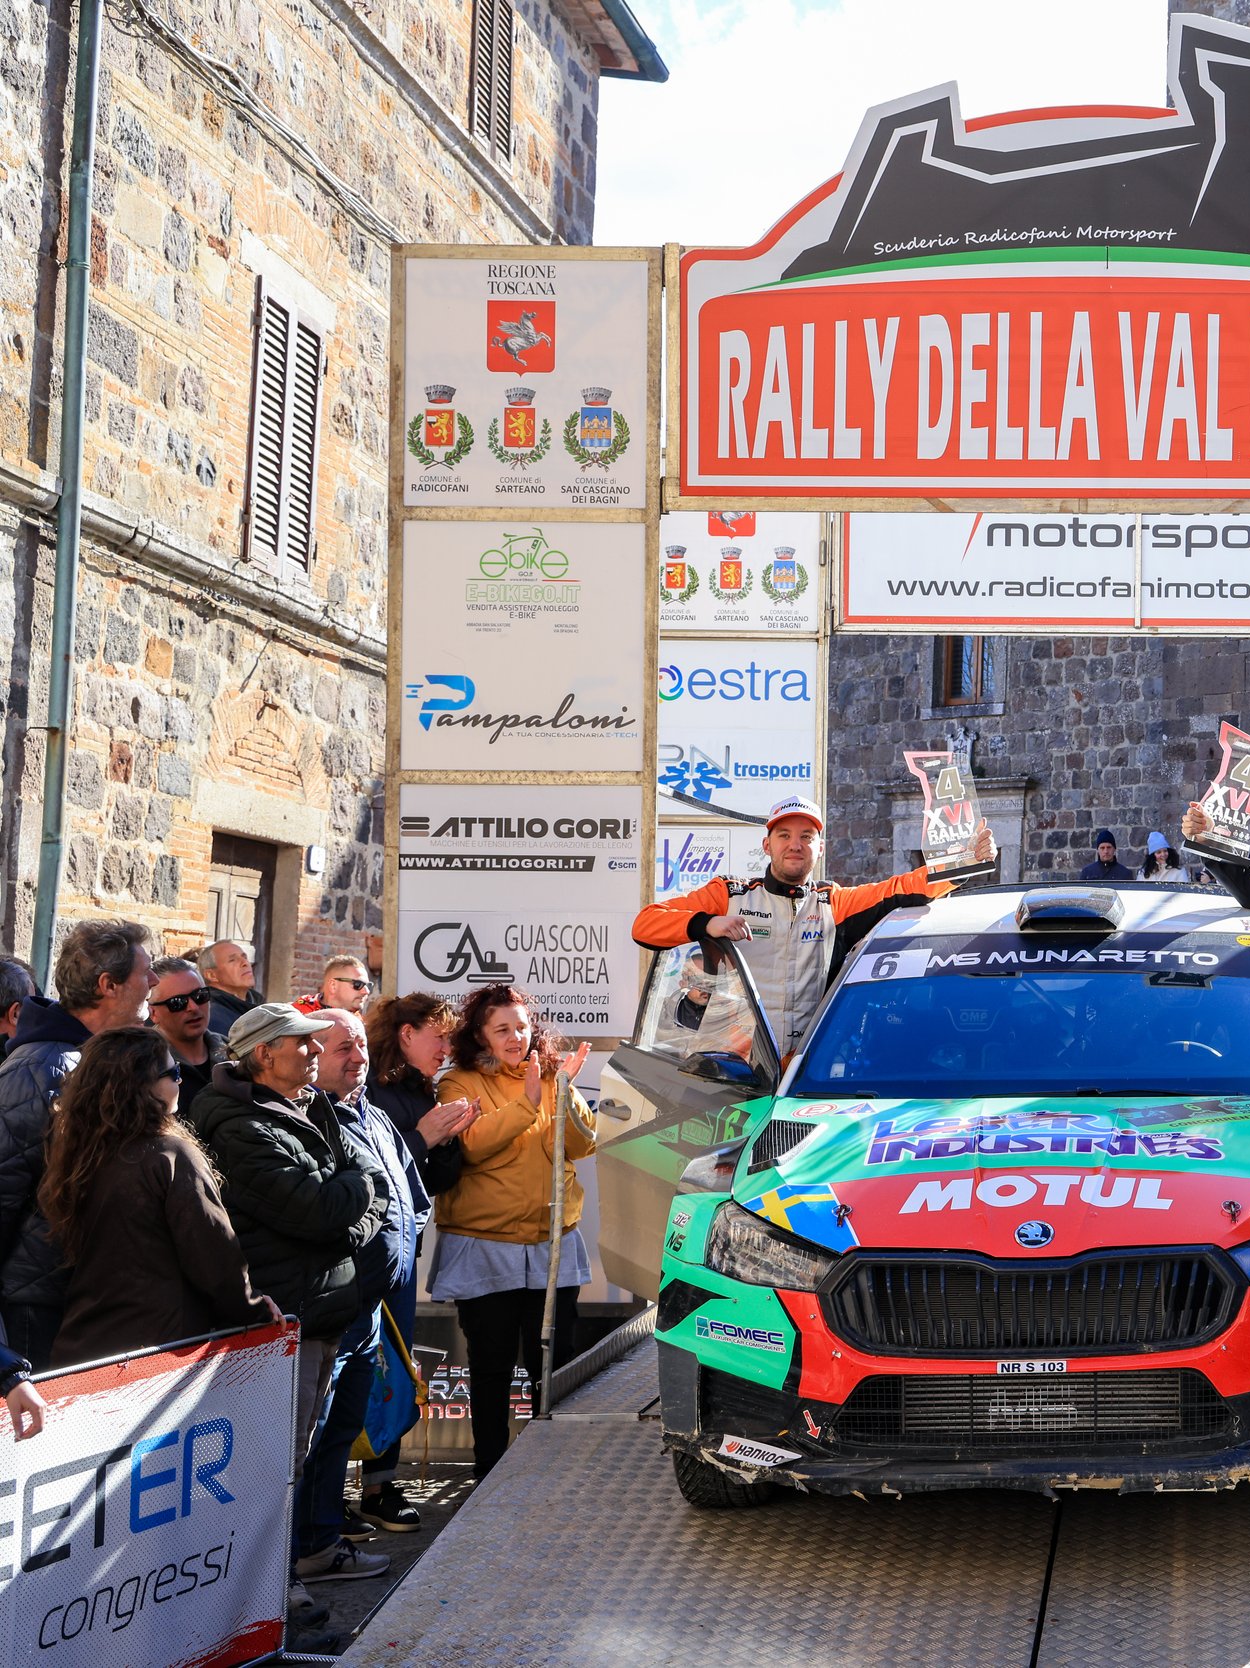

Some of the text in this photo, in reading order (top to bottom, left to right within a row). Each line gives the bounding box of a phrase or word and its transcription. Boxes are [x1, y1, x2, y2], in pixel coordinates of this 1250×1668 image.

[874, 225, 1177, 256] Scuderia Radicofani Motorsport
[487, 264, 556, 279] REGIONE
[487, 281, 556, 296] TOSCANA
[717, 316, 901, 460] RALLY
[916, 311, 1101, 461] DELLA
[1118, 311, 1234, 462] VAL
[411, 483, 469, 493] RADICOFANI
[419, 475, 461, 483] COMUNE di
[500, 476, 541, 484] COMUNE di
[575, 477, 617, 485] COMUNE di
[495, 484, 546, 494] SARTEANO
[561, 485, 631, 495] SAN CASCIANO
[571, 495, 619, 504] DEI BAGNI
[465, 584, 581, 603] E-BIKEGO.IT
[688, 661, 811, 701] estra
[418, 674, 636, 745] Pampaloni
[734, 762, 811, 781] trasporti
[935, 766, 966, 802] 4
[922, 800, 975, 830] XVI
[430, 817, 549, 838] ATTILIO
[553, 818, 631, 840] GORI
[927, 821, 975, 843] RALLY
[539, 841, 590, 849] LAVORAZIONE
[687, 844, 724, 854] impresa
[400, 857, 586, 869] WWW.ATTILIOGORI.IT
[504, 924, 609, 953] GUASCONI
[526, 956, 609, 984] ANDREA
[870, 949, 1219, 979] 6 MS MUNARETTO
[559, 993, 609, 1004] conto terzi
[864, 1130, 1226, 1166] INDUSTRIES
[898, 1175, 1175, 1214] MOTUL
[709, 1321, 784, 1346] FOMEC
[1001, 1362, 1064, 1372] NR S 103
[38, 1530, 235, 1650] congressi
